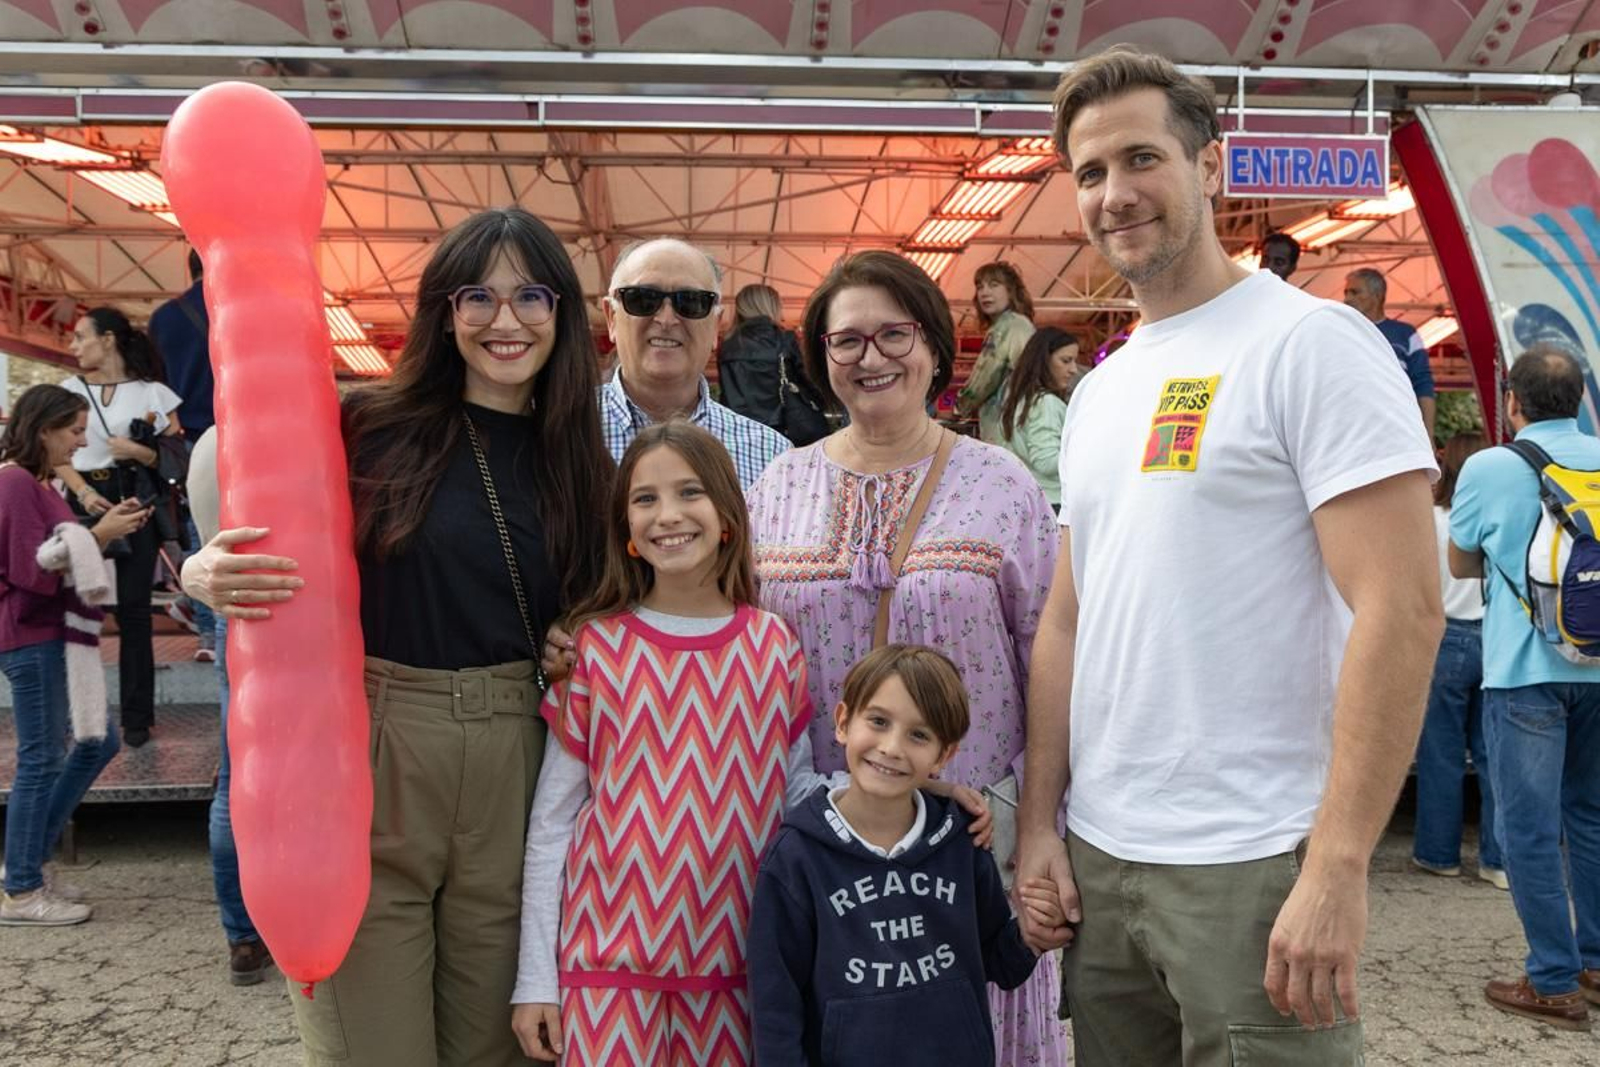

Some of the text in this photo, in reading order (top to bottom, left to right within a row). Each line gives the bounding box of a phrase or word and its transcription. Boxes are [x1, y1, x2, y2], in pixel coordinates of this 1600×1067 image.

[1230, 146, 1382, 187] ENTRADA
[1173, 392, 1210, 411] PASS
[829, 870, 957, 917] REACH
[870, 915, 925, 942] THE
[844, 943, 956, 988] STARS
